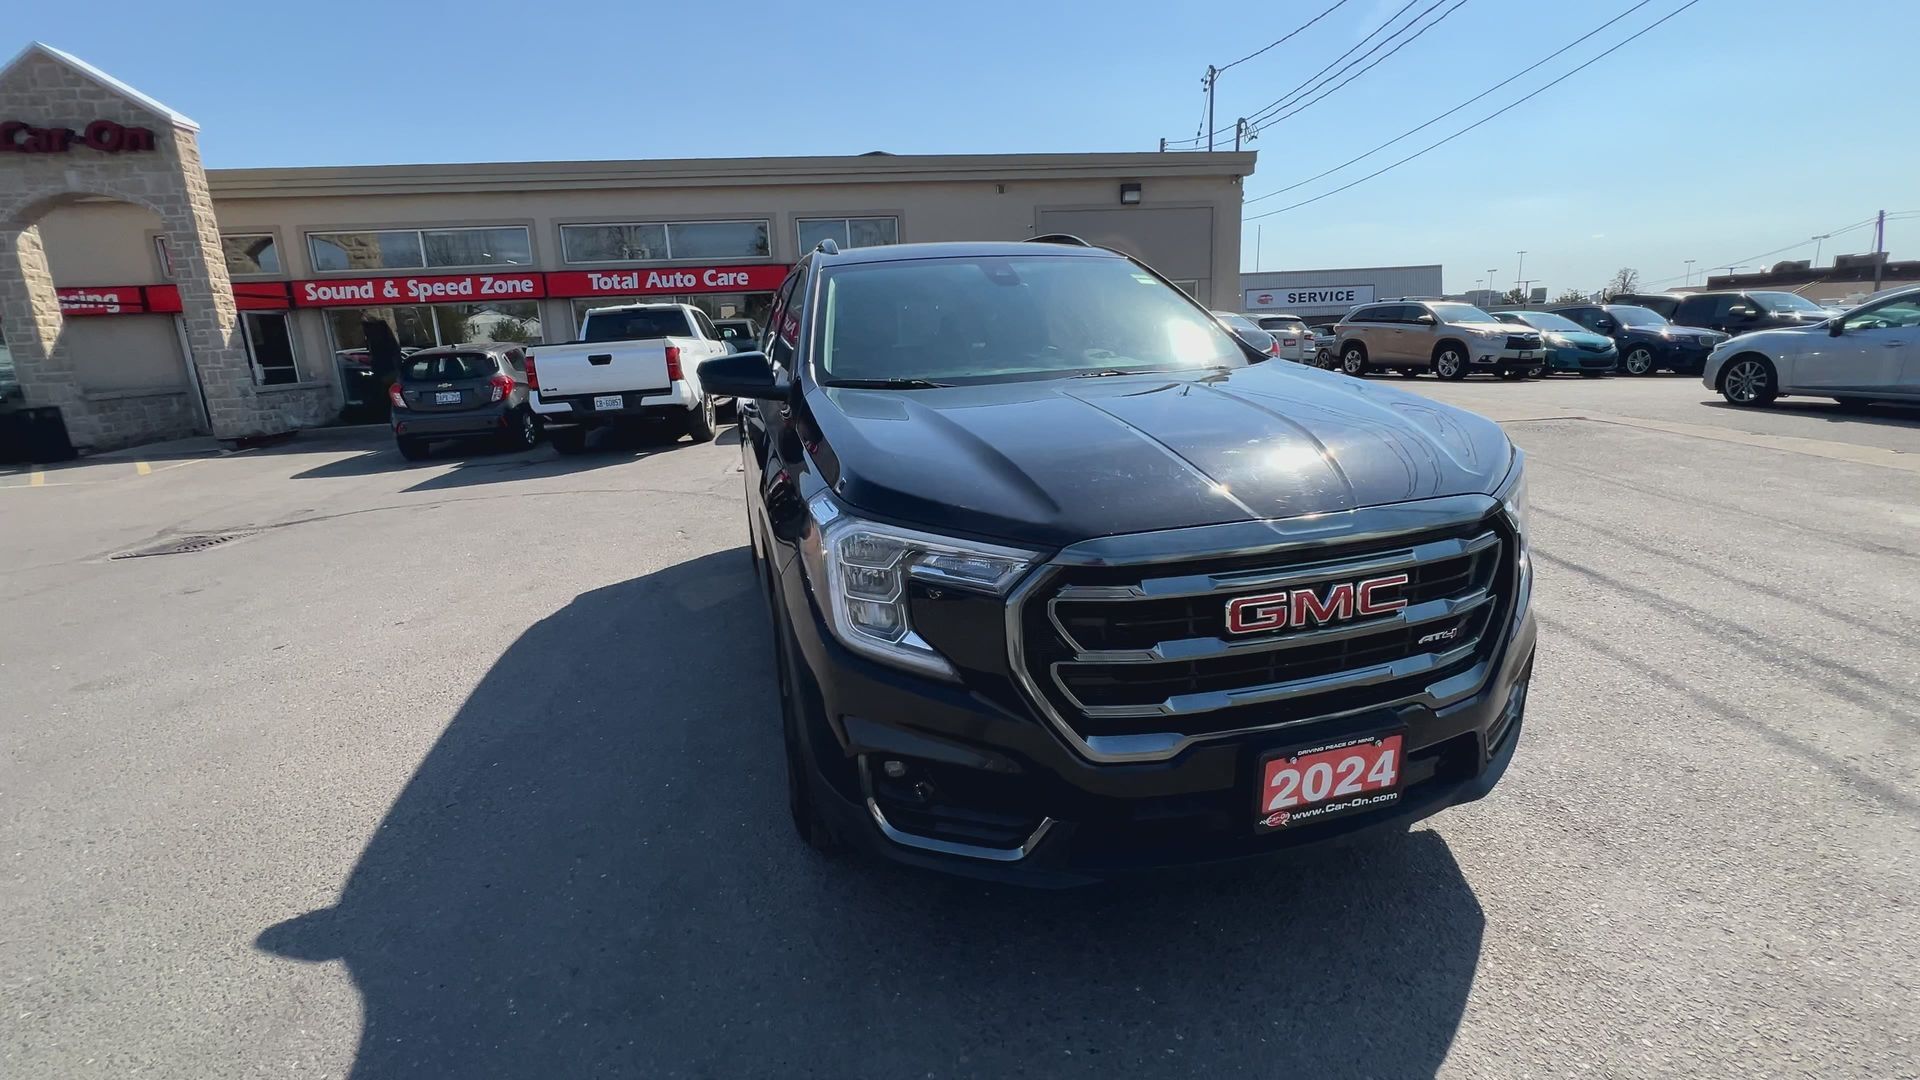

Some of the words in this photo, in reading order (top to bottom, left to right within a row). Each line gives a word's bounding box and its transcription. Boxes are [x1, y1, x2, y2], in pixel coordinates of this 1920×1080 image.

[0, 120, 155, 153] Car-On
[304, 281, 374, 301] Sound
[382, 280, 400, 298] &
[407, 278, 472, 302] Speed
[480, 277, 534, 294] Zone
[588, 272, 638, 290] Total
[645, 271, 696, 288] Auto
[703, 269, 749, 286] Care
[1288, 290, 1355, 303] SERVICE
[1225, 574, 1408, 634] GMC
[1418, 628, 1457, 644] AT4
[1297, 746, 1324, 756] DRIVING
[1325, 741, 1347, 750] PEACE
[1357, 736, 1375, 745] MIND
[1268, 750, 1395, 811] 2024
[1292, 792, 1398, 820] www.Car-On.com
